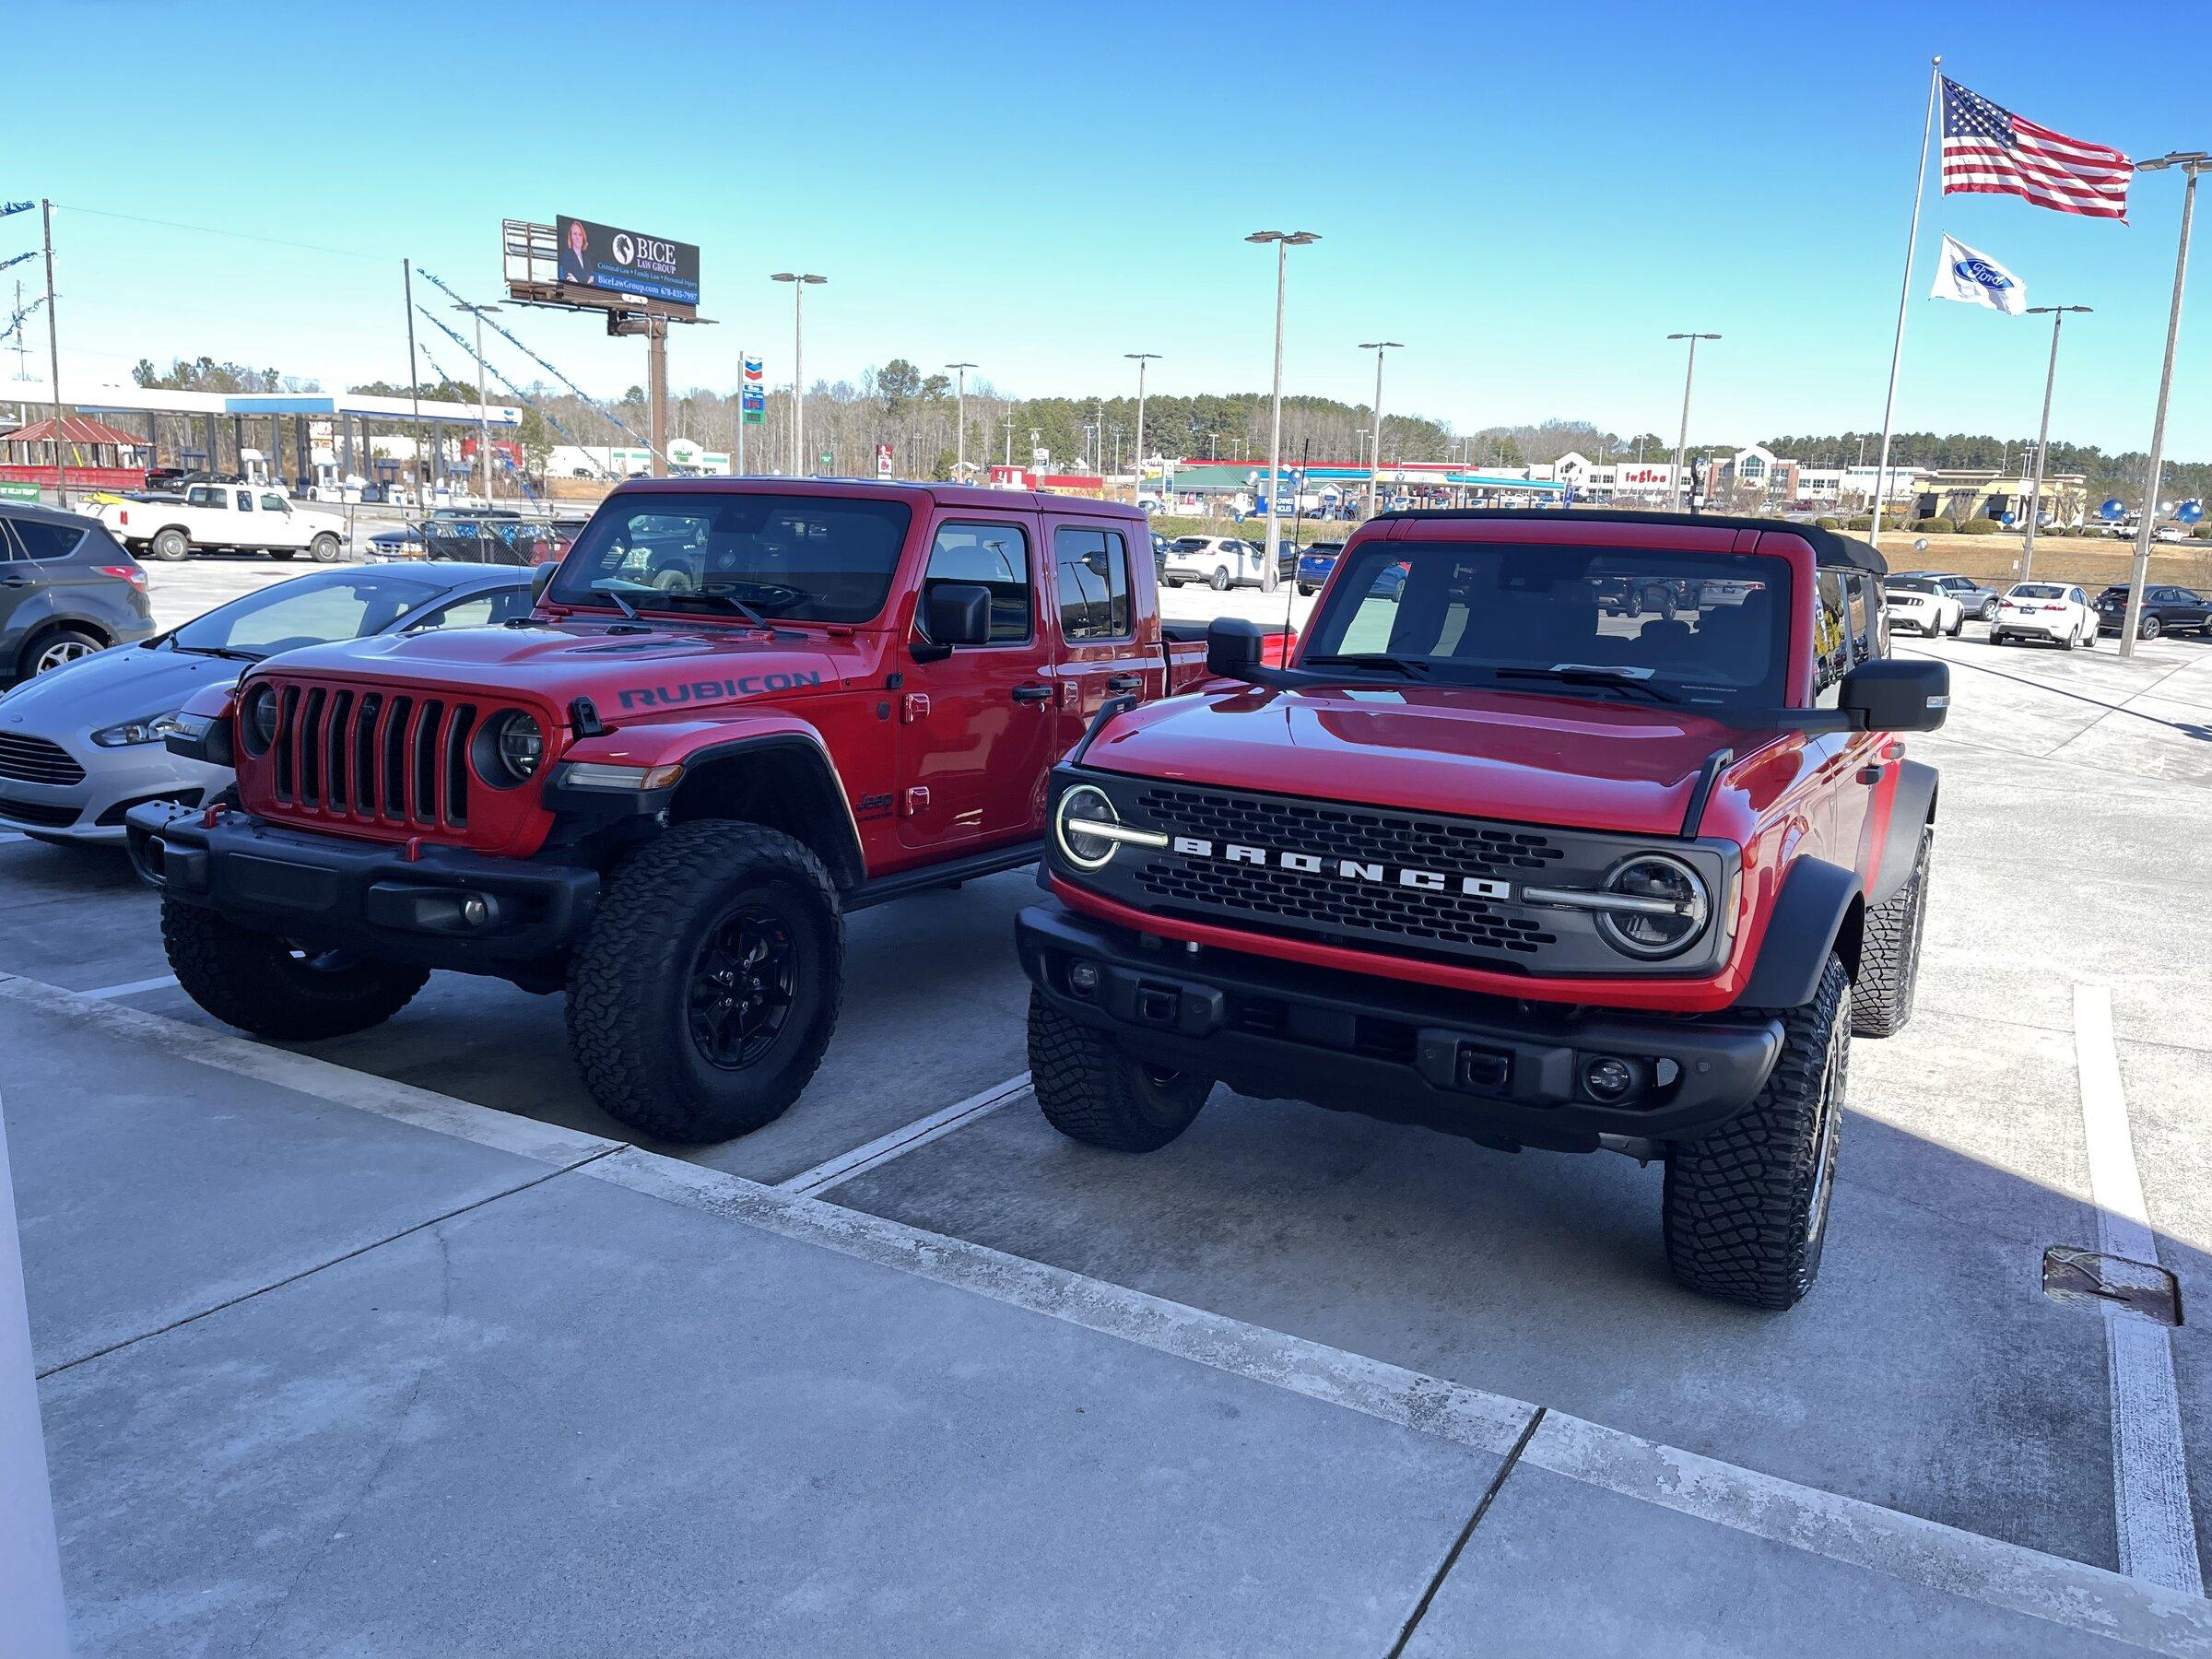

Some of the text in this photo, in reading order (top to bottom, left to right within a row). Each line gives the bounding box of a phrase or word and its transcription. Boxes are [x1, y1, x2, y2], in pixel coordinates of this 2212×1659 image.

[636, 237, 676, 265] BICE
[597, 262, 619, 273] Criminal
[619, 266, 629, 275] Law
[664, 275, 684, 285] Personal
[637, 259, 677, 275] LAW GROUP
[1966, 262, 2005, 287] Ford
[598, 275, 659, 294] BiceLawGroup.com
[618, 671, 820, 709] RUBICON
[855, 792, 893, 812] Jeep
[1173, 836, 1511, 900] BRONCO
